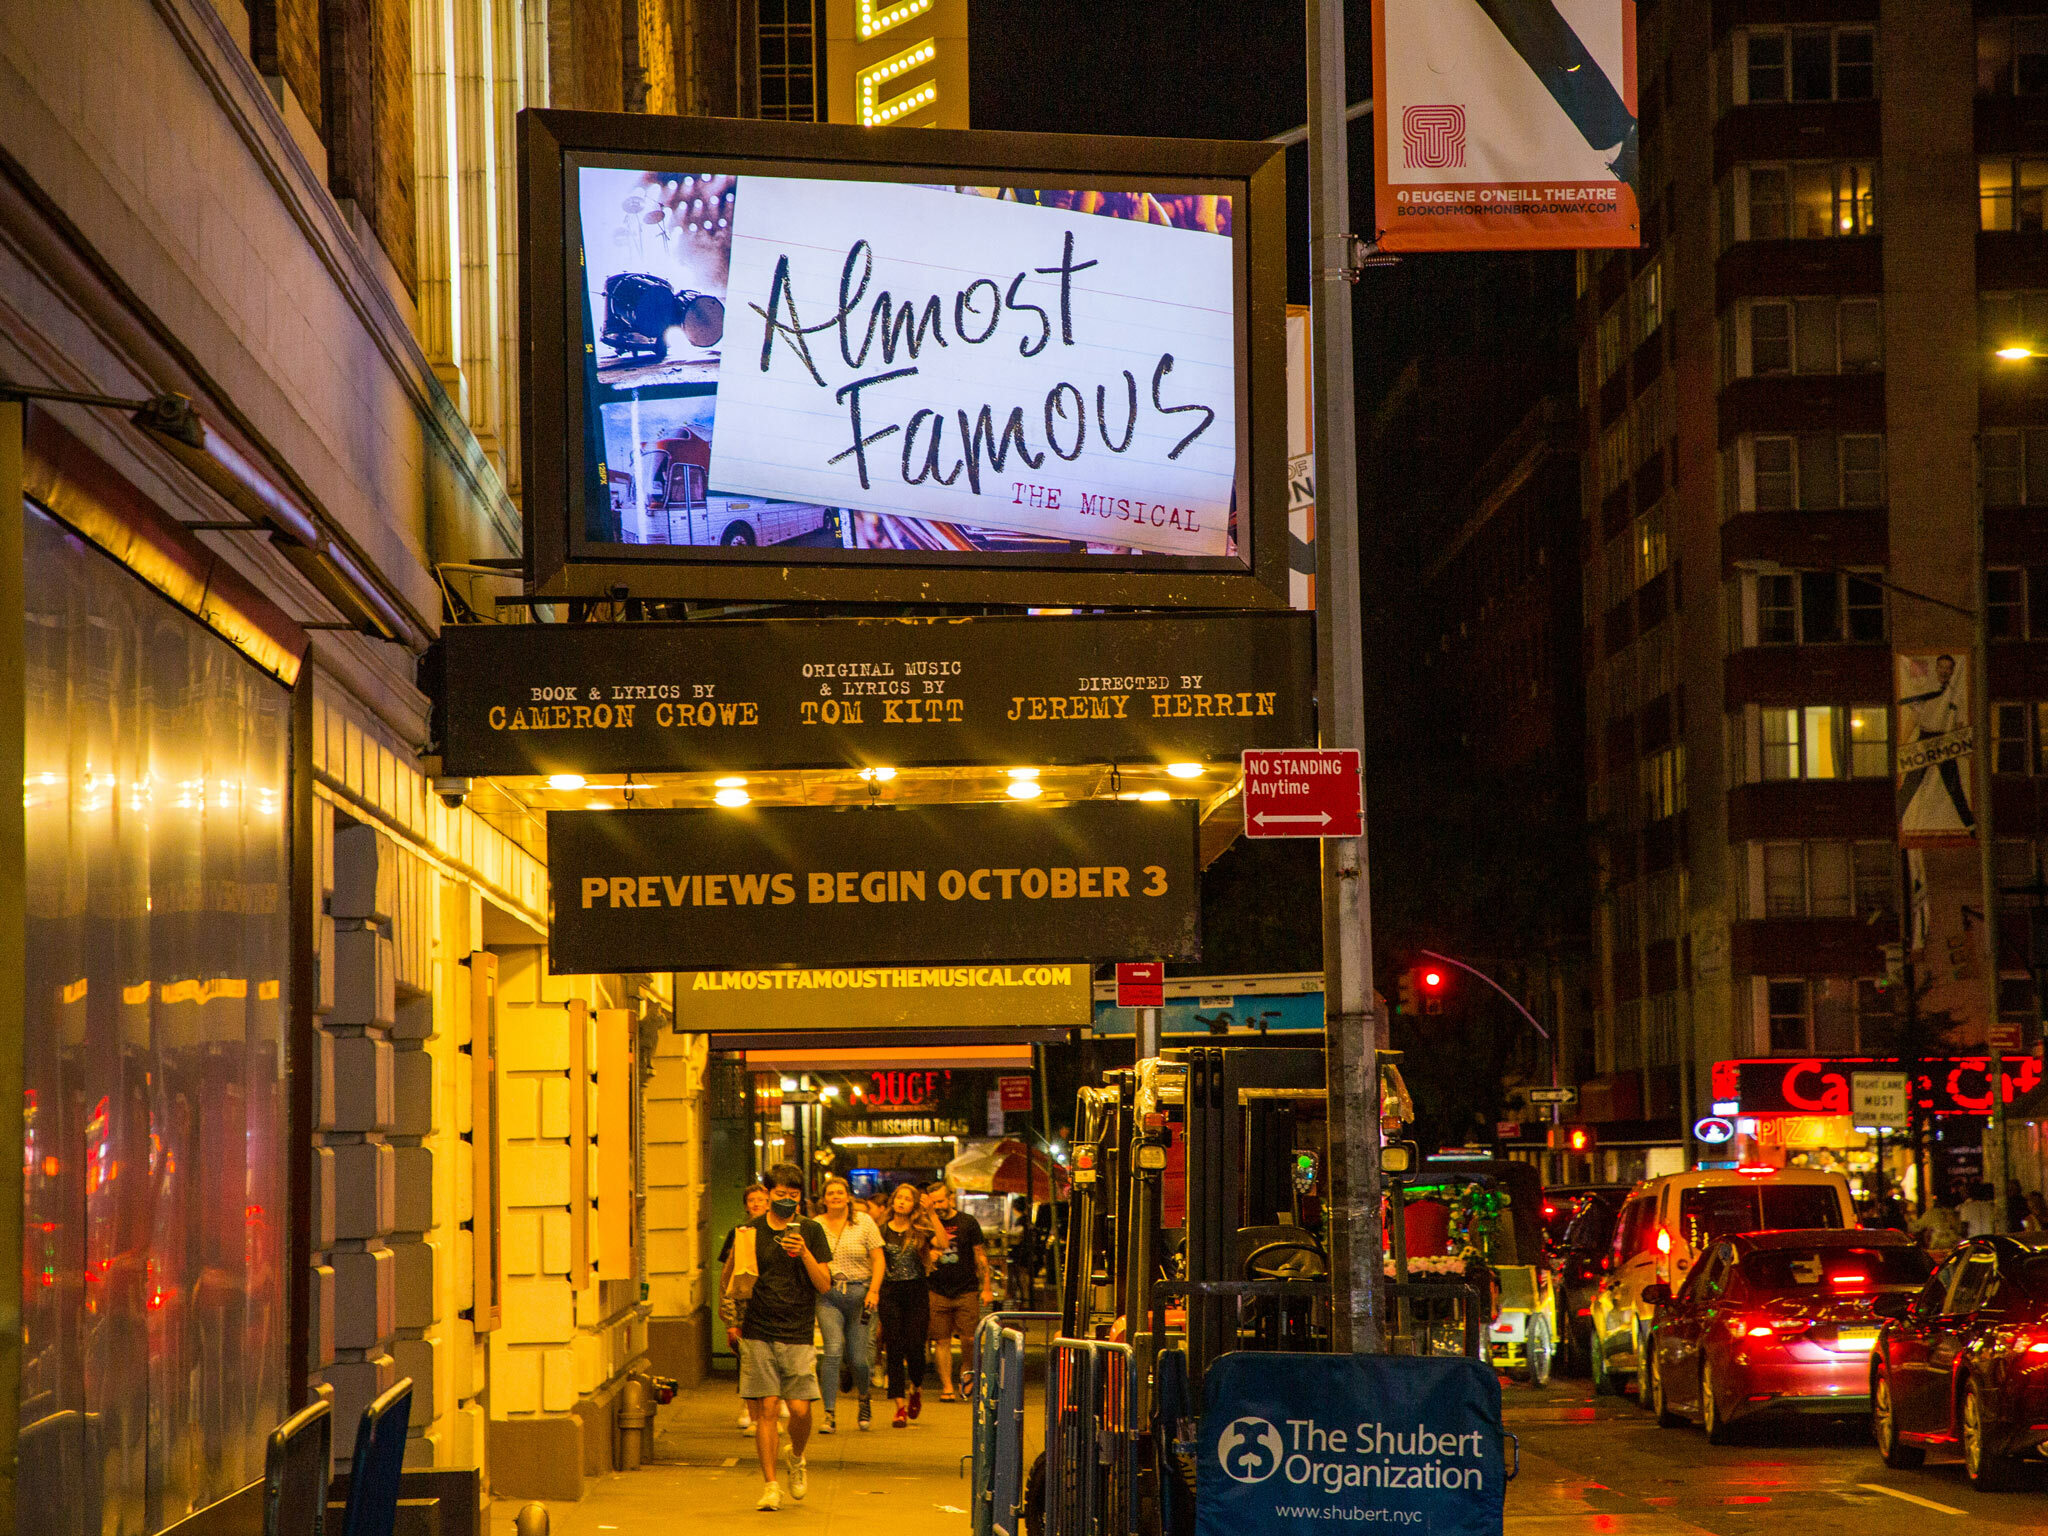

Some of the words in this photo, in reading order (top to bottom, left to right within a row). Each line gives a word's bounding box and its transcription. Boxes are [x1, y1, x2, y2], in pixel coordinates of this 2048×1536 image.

[1412, 190, 1476, 203] EUGENE
[1479, 188, 1542, 202] O'NEILL
[1544, 187, 1617, 201] THEATRE
[1397, 203, 1617, 217] BOOKOFMORMONBROADWAY.COM
[748, 231, 1098, 386] Almost
[828, 353, 1214, 494] Famous
[1011, 482, 1064, 511] THE
[1080, 492, 1200, 533] MUSICAL
[802, 663, 895, 677] ORIGINAL
[905, 661, 962, 676] MUSIC
[531, 687, 577, 701] BOOK
[588, 687, 601, 700] &
[612, 685, 680, 699] LYRICS
[692, 684, 716, 699] BY
[820, 682, 832, 695] &
[842, 681, 911, 695] LYRICS
[923, 680, 945, 694] BY
[1078, 676, 1169, 691] DIRECTED
[1180, 675, 1204, 690] BY
[488, 704, 635, 731] CAMERON
[656, 702, 760, 727] CROWE
[801, 700, 863, 725] TOM
[883, 698, 965, 723] KITT
[1007, 694, 1130, 721] JEREMY
[1151, 692, 1276, 717] HERRIN
[1249, 760, 1269, 775] NO
[1273, 759, 1343, 775] STANDING
[1251, 779, 1310, 795] Anytime
[581, 872, 795, 908] PREVIEWS
[807, 870, 928, 905] BEGIN
[938, 867, 1131, 902] OCTOBER
[1142, 865, 1169, 897] 3
[692, 967, 1072, 990] ALMOSTFAMOUSTHEMUSICAL.COM
[1286, 1419, 1348, 1452] The
[1356, 1423, 1483, 1457] Shubert
[1285, 1454, 1483, 1494] Organization
[1275, 1505, 1423, 1523] www.shubert.nyc
